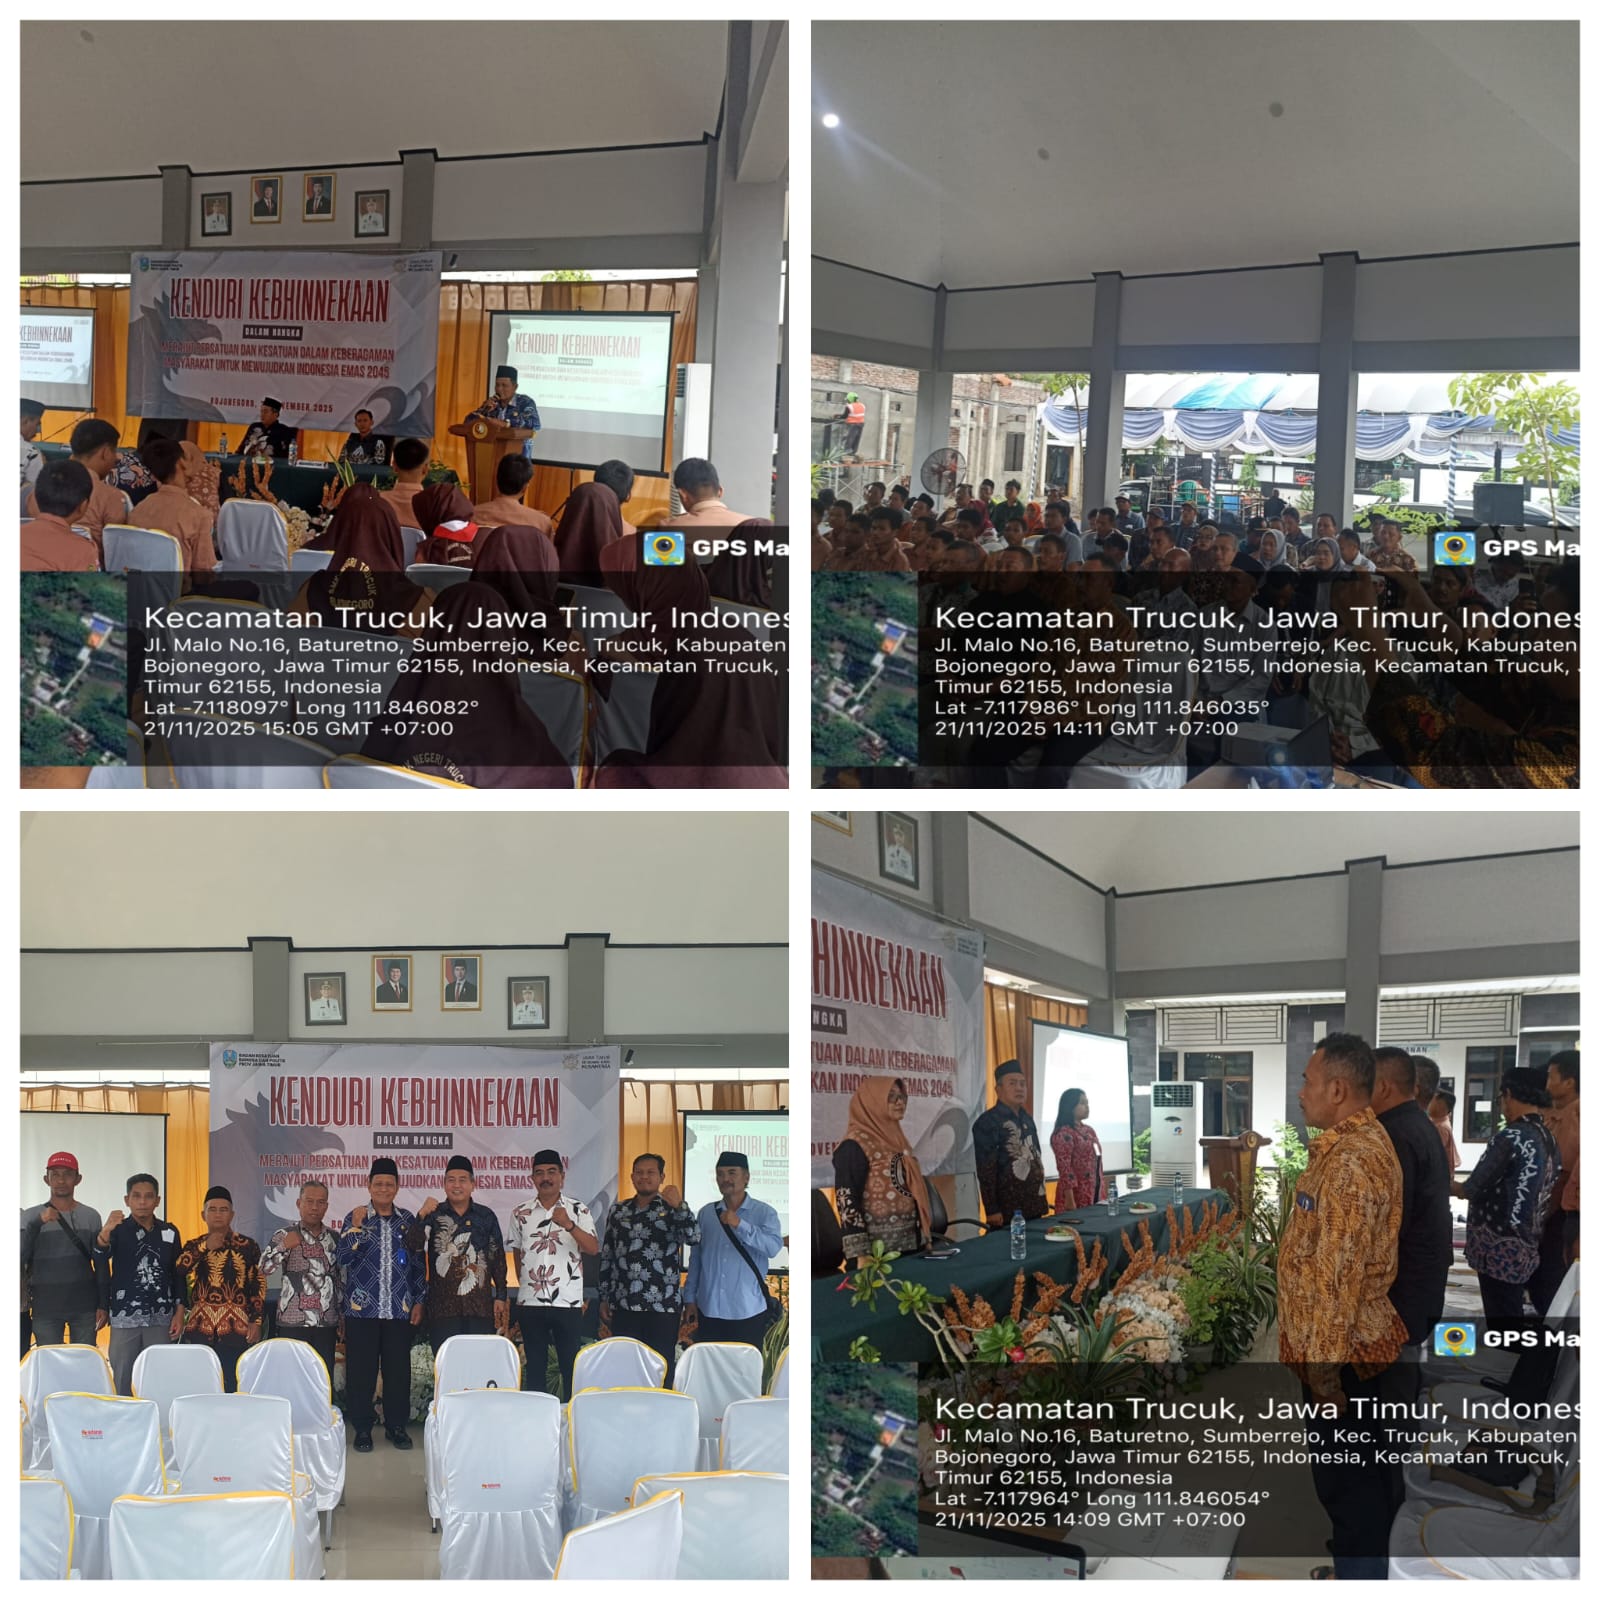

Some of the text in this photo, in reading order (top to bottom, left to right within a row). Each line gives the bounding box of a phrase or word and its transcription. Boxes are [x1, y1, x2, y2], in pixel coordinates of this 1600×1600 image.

[170, 278, 391, 323] KENDURI KEBHINNEKAAN
[196, 343, 239, 356] PERSATUAN
[241, 344, 257, 357] DAN
[258, 344, 298, 359] KESATUAN
[300, 345, 329, 360] DALAM
[331, 346, 394, 362] KEBERAGAMAN
[515, 332, 641, 359] KENDURI KEBHINNEKAAN
[215, 359, 240, 372] UNTUK
[242, 360, 295, 375] MEWUJUDKAN
[296, 362, 339, 377] INDONESIA
[341, 363, 365, 378] EMAS
[367, 364, 390, 379] 2045
[313, 404, 333, 413] 2025
[412, 752, 444, 767] NEGERI
[845, 1046, 885, 1070] DALAM
[887, 1051, 957, 1075] KEBERAGAMAN
[930, 1079, 954, 1098] 2045
[269, 1075, 560, 1127] KENDURI KEBHINNEKAAN
[376, 1135, 450, 1146] DALAM RANGKA
[766, 1136, 789, 1158] KEB
[259, 1154, 306, 1168] MERAJUT
[309, 1155, 369, 1168] PERSATUAN
[395, 1155, 448, 1170] KESATUAN
[337, 1174, 370, 1188] UNTUK
[504, 1175, 533, 1189] EMAS
